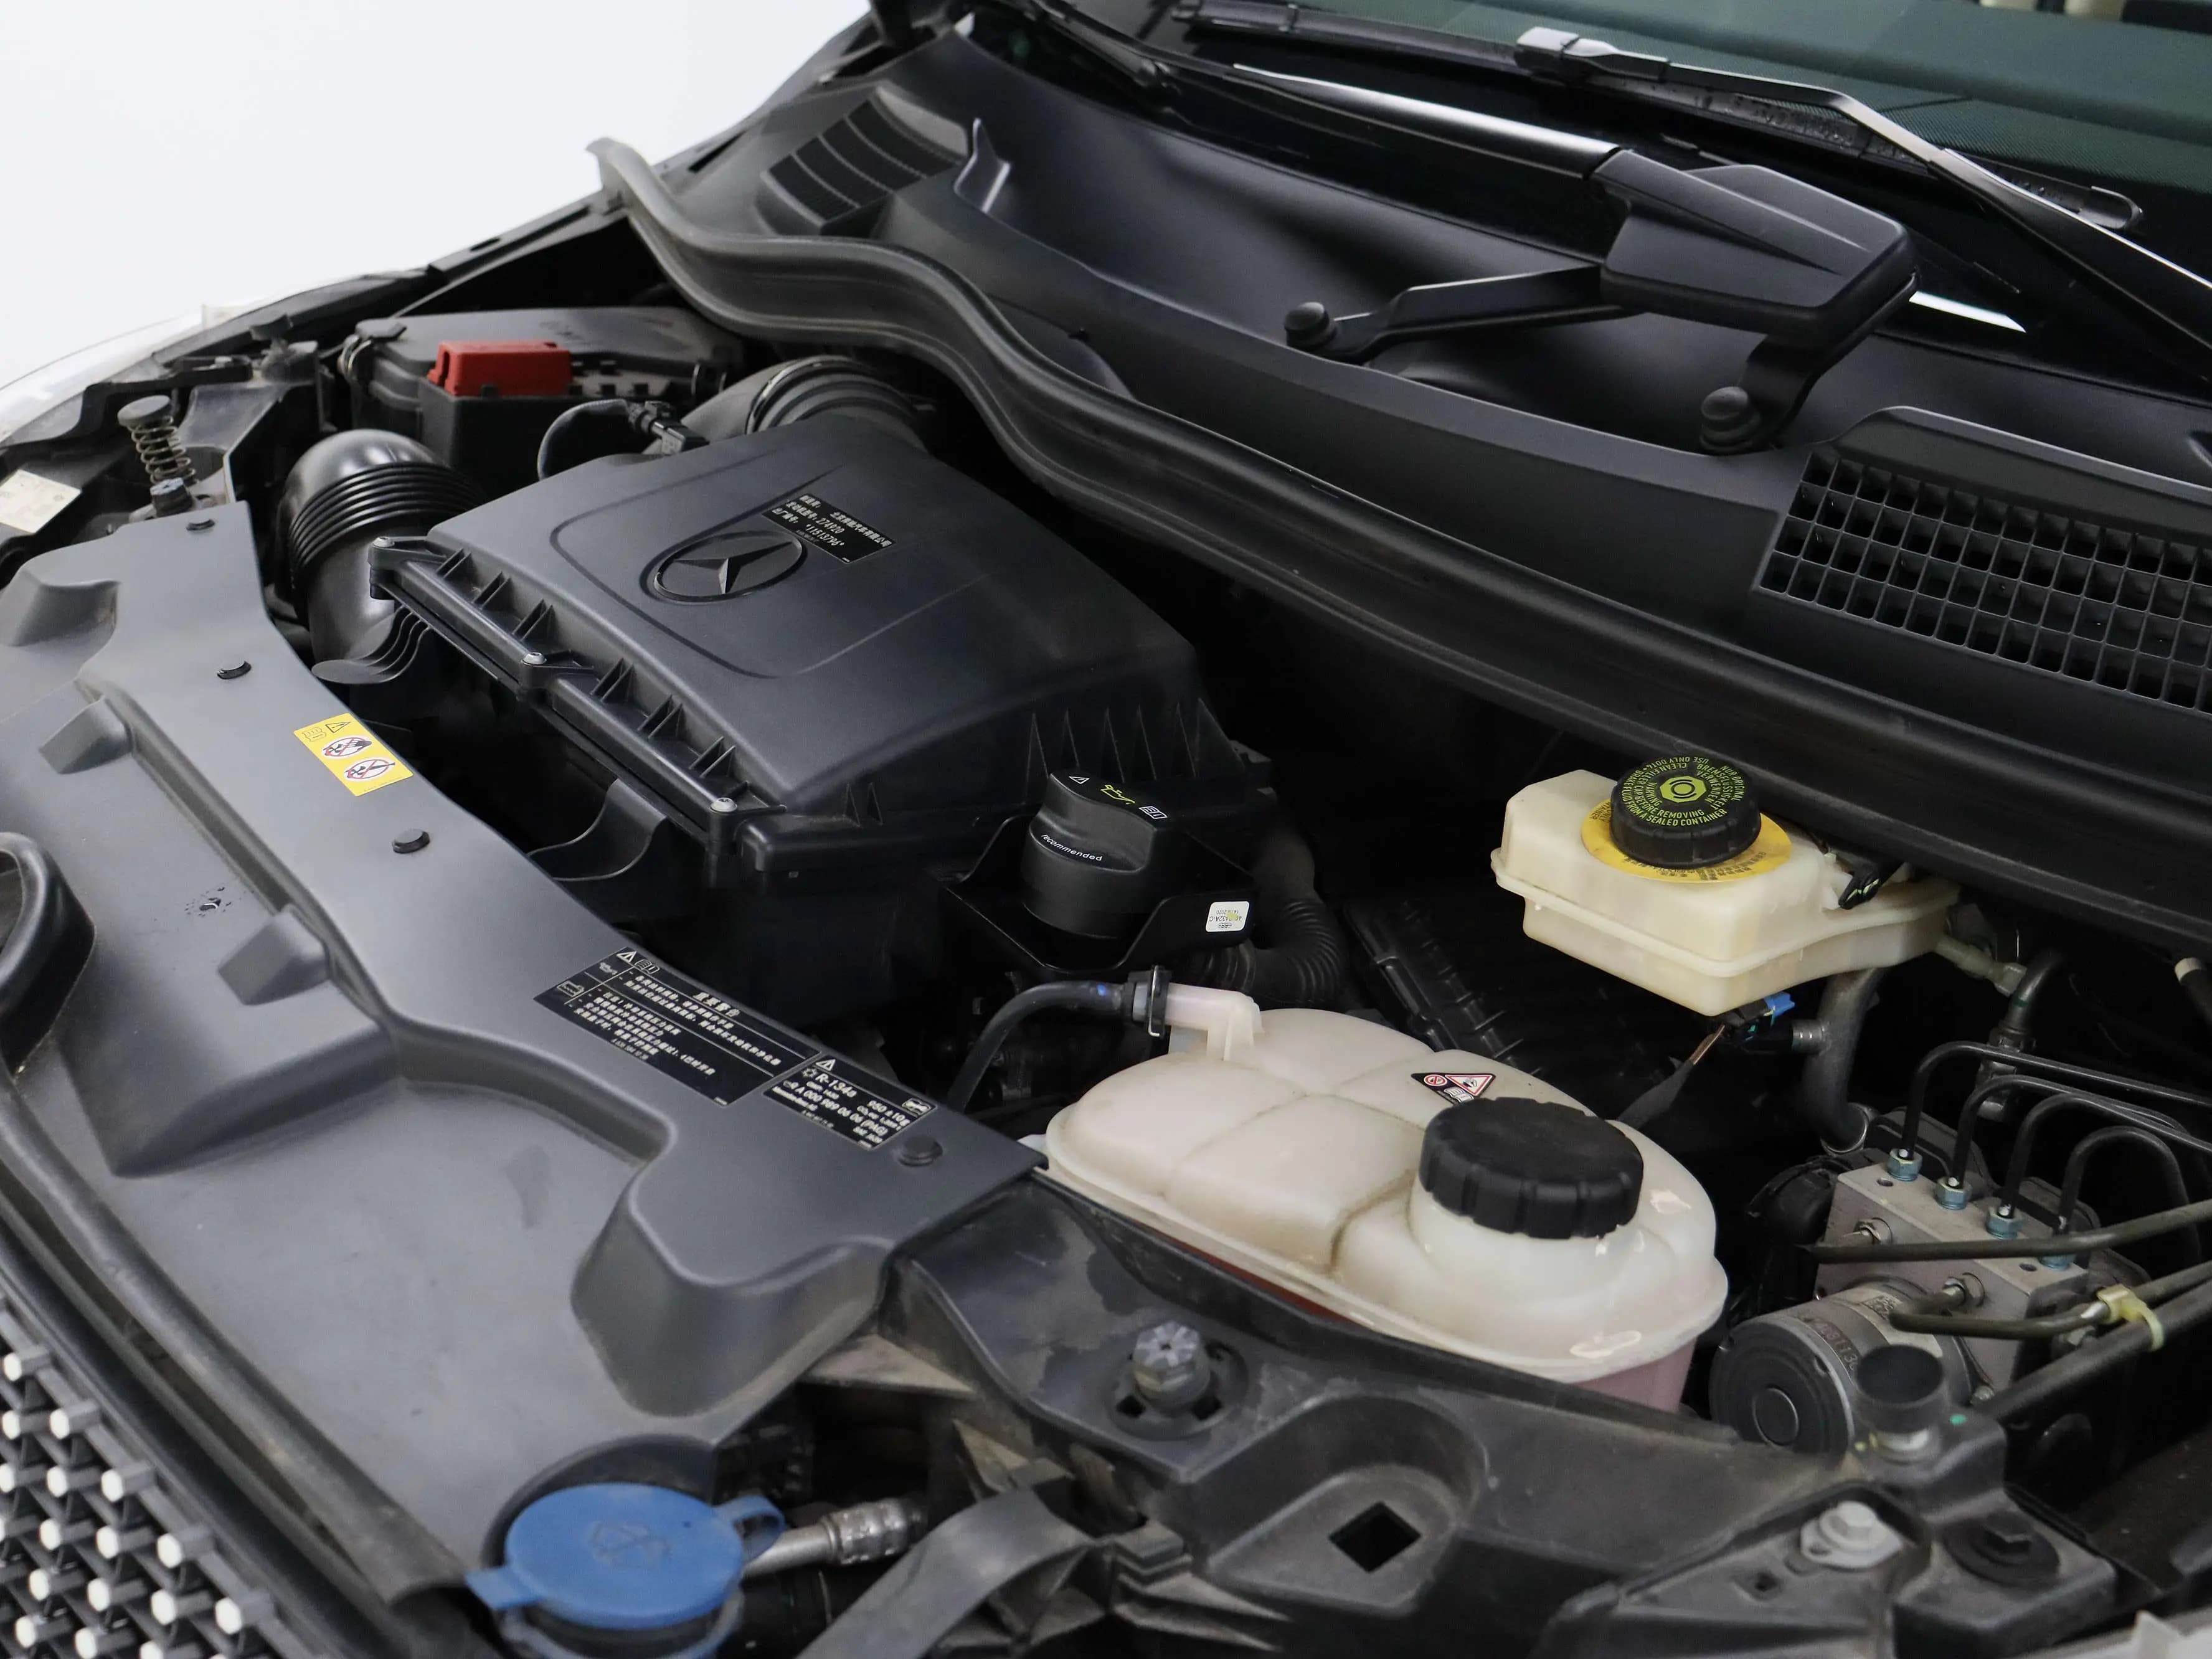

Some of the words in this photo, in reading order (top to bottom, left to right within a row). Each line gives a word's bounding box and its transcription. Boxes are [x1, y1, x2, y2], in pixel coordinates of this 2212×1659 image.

[1659, 762, 1687, 772] CLEAN
[1624, 770, 1644, 786] BRAKE
[1636, 768, 1660, 785] FILLER
[1719, 765, 1737, 776] NUR
[1731, 776, 1745, 801] ORIGINAL
[1622, 787, 1632, 801] FLUID
[1633, 785, 1643, 796] CAP
[1645, 782, 1663, 806] WARNING
[1696, 770, 1721, 803] VERWENDEN
[1624, 801, 1642, 815] FROM
[1634, 796, 1659, 815] BEFORE
[1646, 815, 1678, 826] SEALED
[1658, 809, 1704, 820] REMOVING
[1681, 808, 1728, 826] CONTAINER
[1041, 834, 1102, 861] recommended
